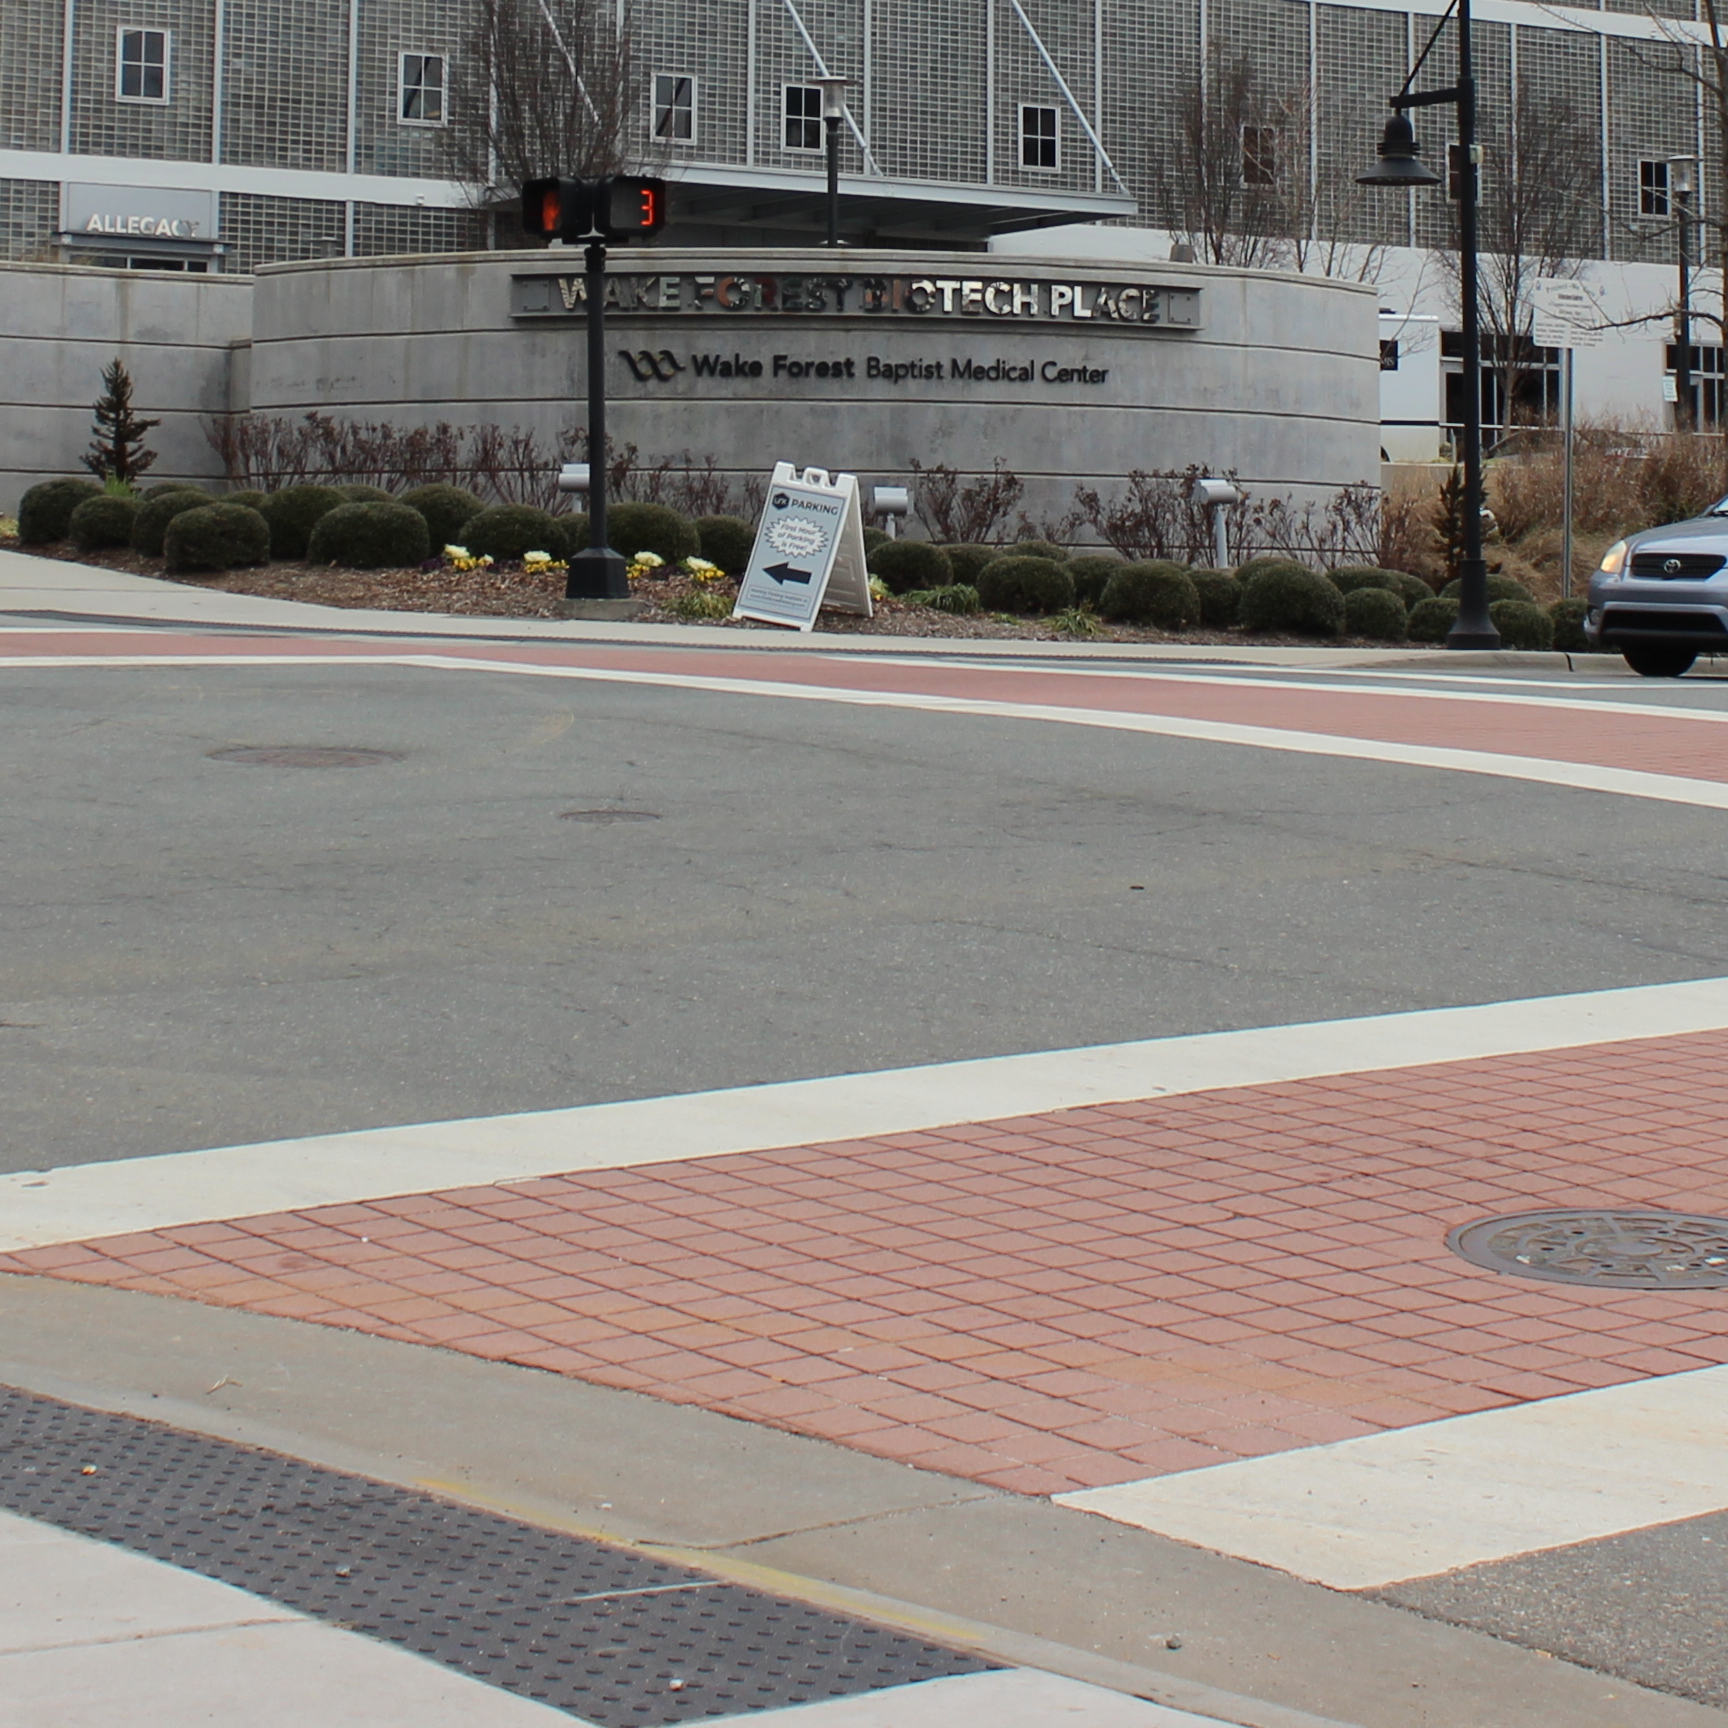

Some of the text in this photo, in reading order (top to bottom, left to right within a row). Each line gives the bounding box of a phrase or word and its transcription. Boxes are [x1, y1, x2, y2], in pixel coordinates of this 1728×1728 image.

[640, 189, 654, 226] 3
[86, 213, 200, 238] ALLEGACY
[557, 276, 1160, 322] WAKE FOREST BIOTECH PLACE
[691, 353, 1109, 384] Wake Forest Baptist Medical Center
[791, 498, 839, 515] PARKING
[780, 524, 817, 536] First Hour
[786, 533, 816, 546] Parking
[789, 542, 809, 551] Free!
